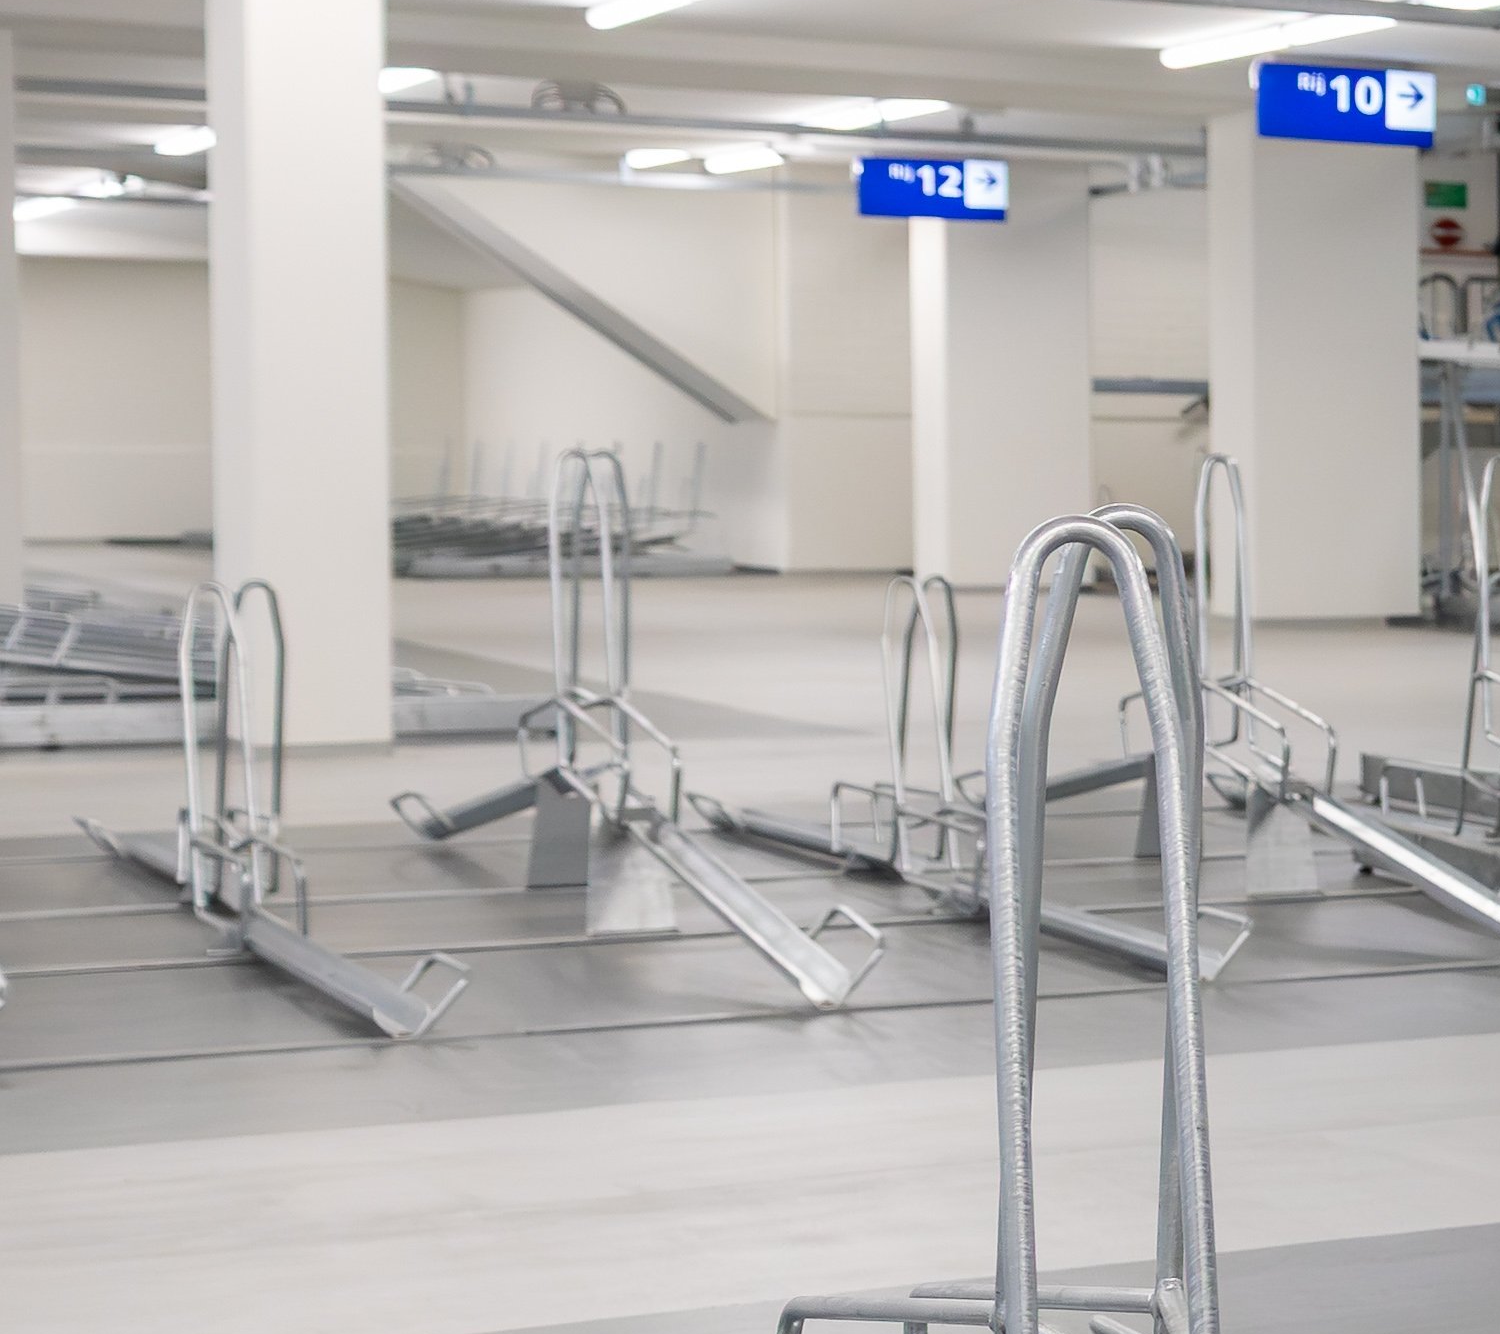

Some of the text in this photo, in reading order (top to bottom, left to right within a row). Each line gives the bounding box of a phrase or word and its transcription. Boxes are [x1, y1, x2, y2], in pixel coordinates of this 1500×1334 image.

[1297, 72, 1383, 115] Rij 10
[917, 165, 961, 198] 12
